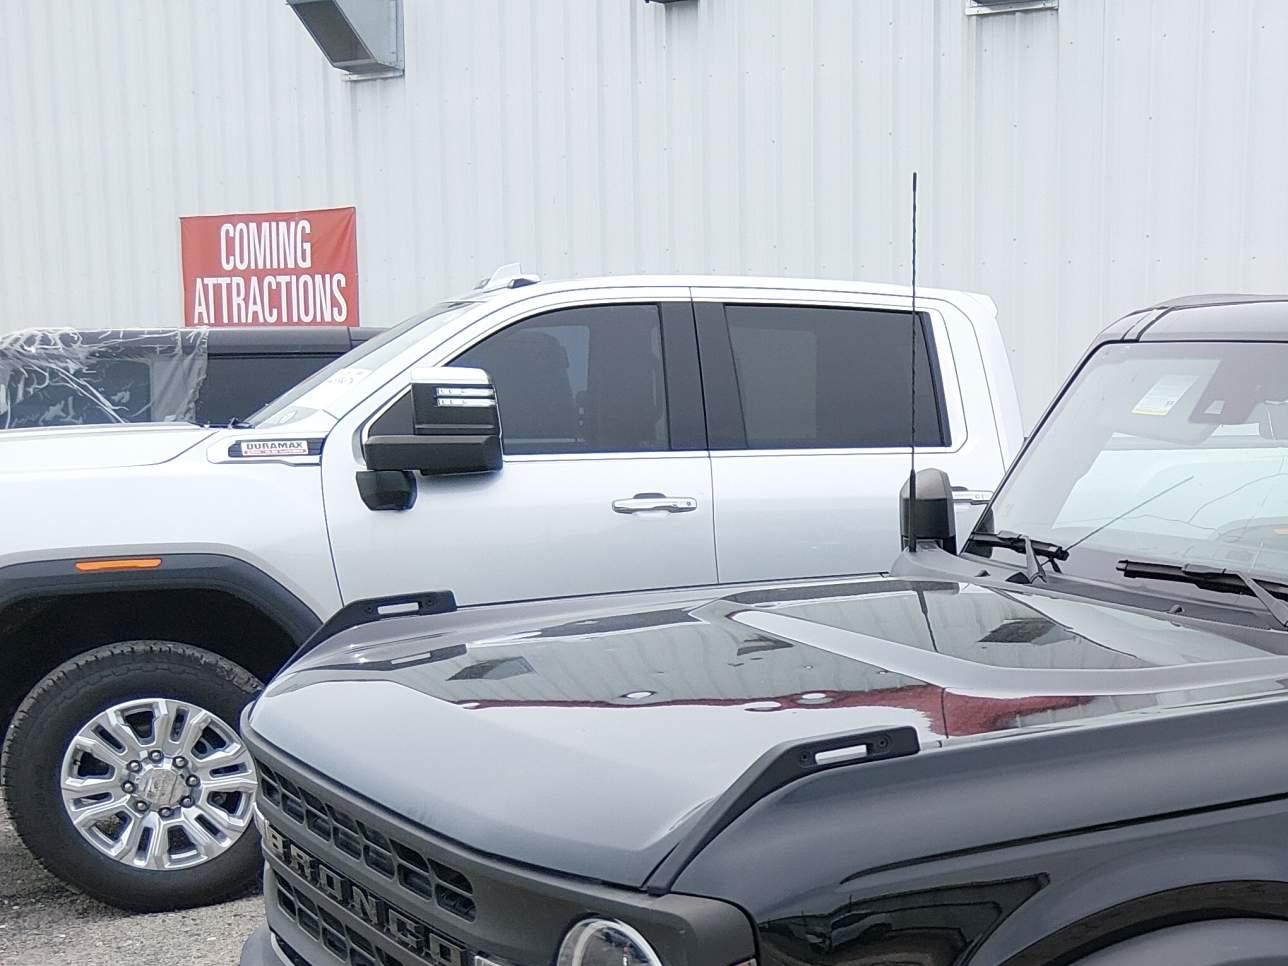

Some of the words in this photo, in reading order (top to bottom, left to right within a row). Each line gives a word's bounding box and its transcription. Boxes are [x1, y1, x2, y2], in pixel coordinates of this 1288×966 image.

[220, 219, 312, 271] COMING
[193, 273, 348, 324] ATTRACTIONS
[246, 442, 304, 450] DURAMAX
